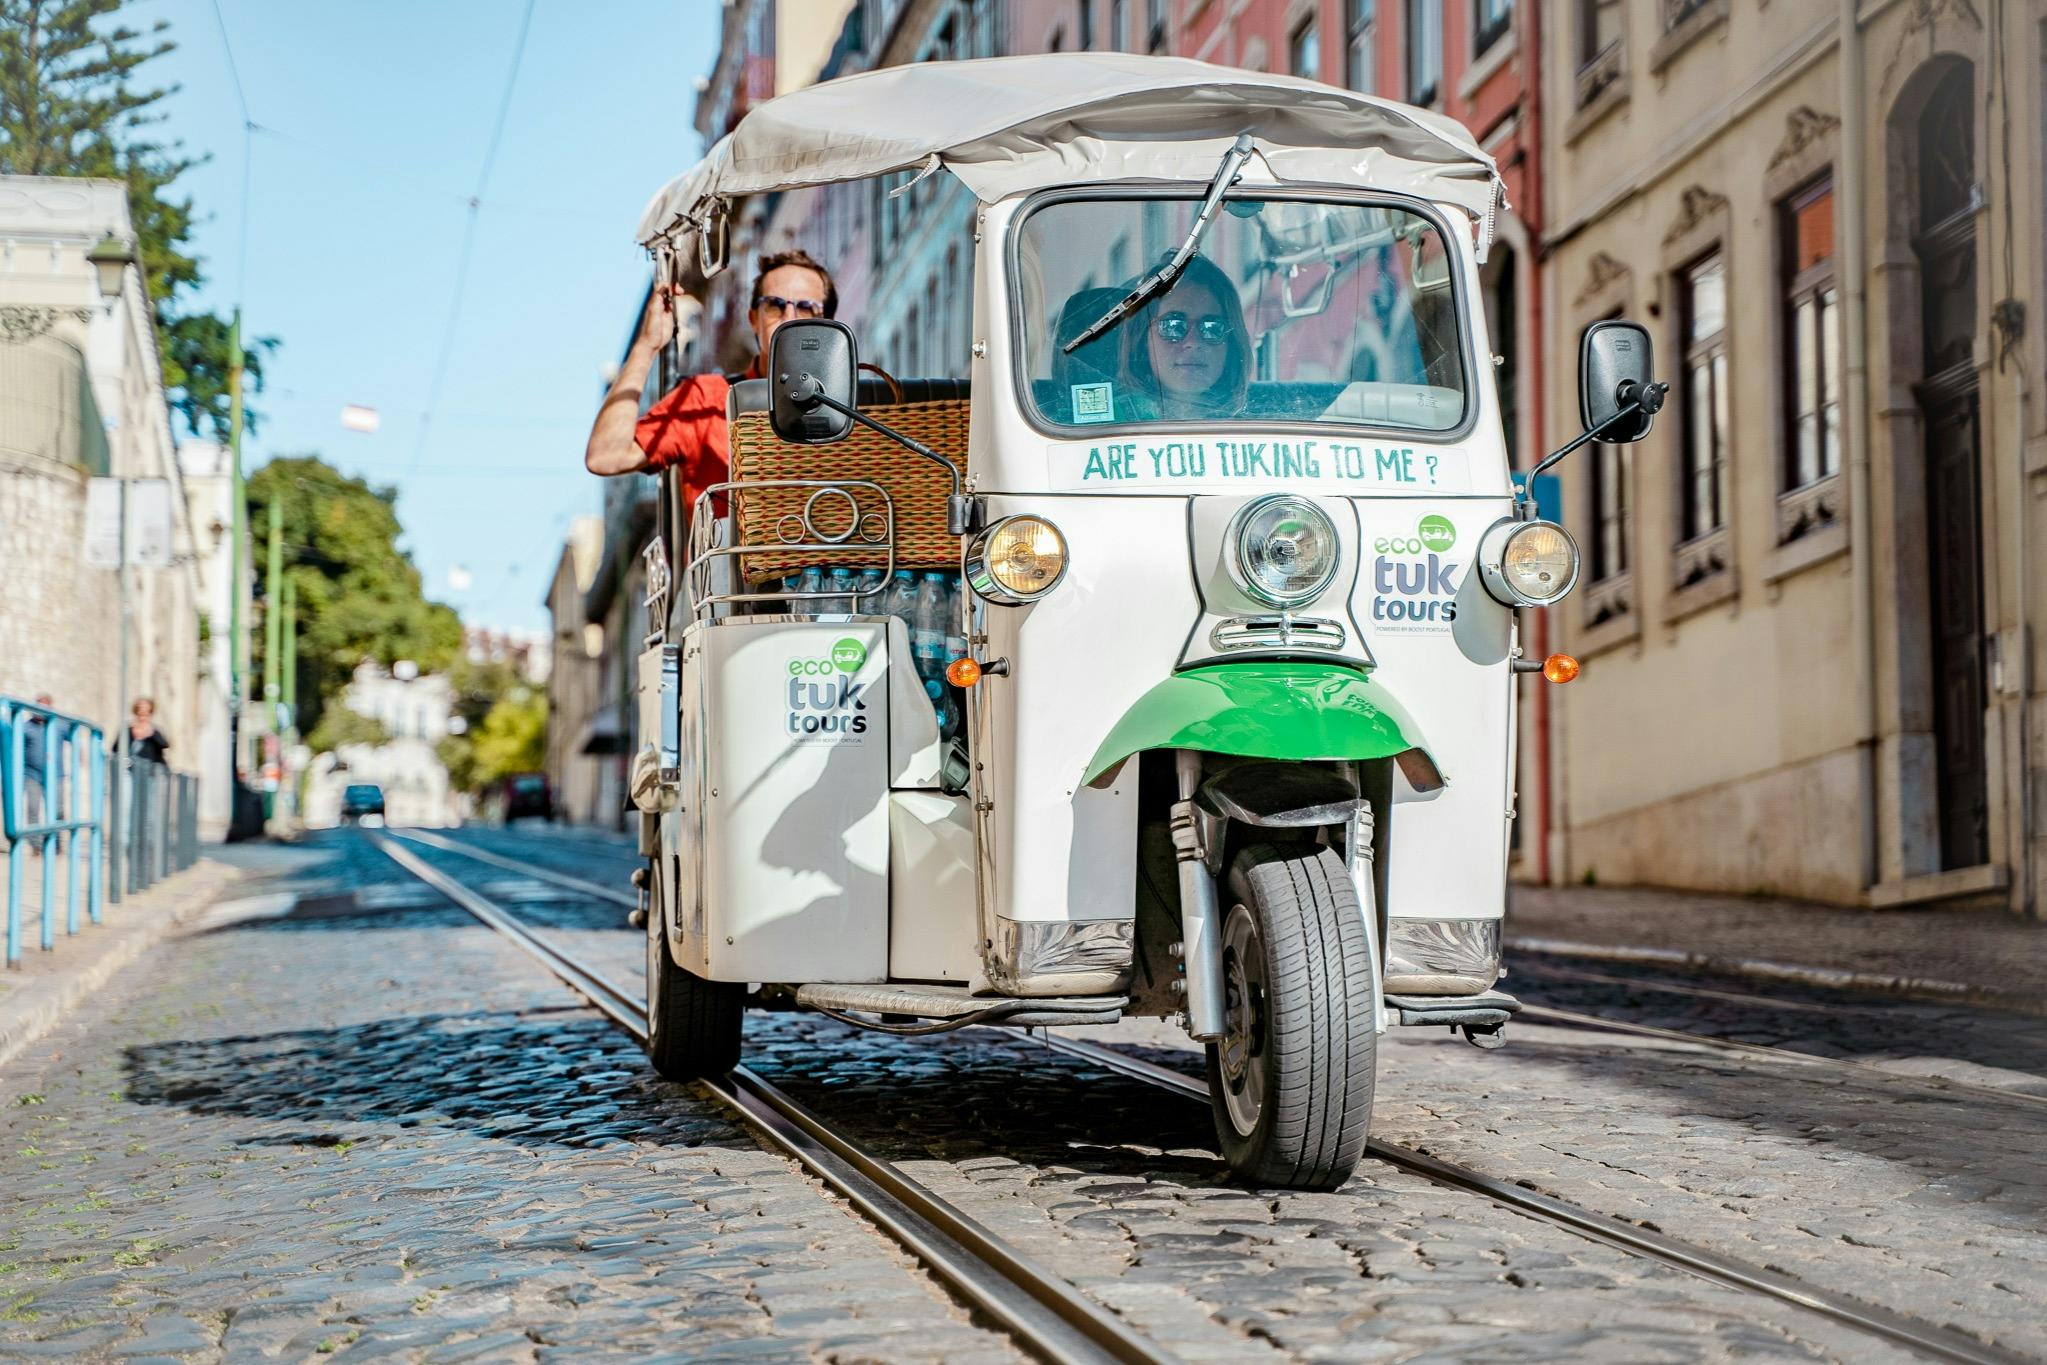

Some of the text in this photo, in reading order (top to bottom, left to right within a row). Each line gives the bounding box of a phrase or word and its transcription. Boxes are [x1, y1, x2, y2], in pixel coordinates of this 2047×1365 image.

[1083, 444, 1138, 480] ARE
[1147, 443, 1206, 478] YOU
[1216, 441, 1320, 478] TUKING
[1329, 444, 1365, 479] TO
[1374, 448, 1416, 482] ME
[1374, 537, 1422, 554] eco
[1375, 553, 1458, 595] tuk
[1373, 595, 1457, 621] tours
[789, 660, 833, 675] eco
[789, 675, 866, 710] tuk
[789, 712, 867, 733] tours
